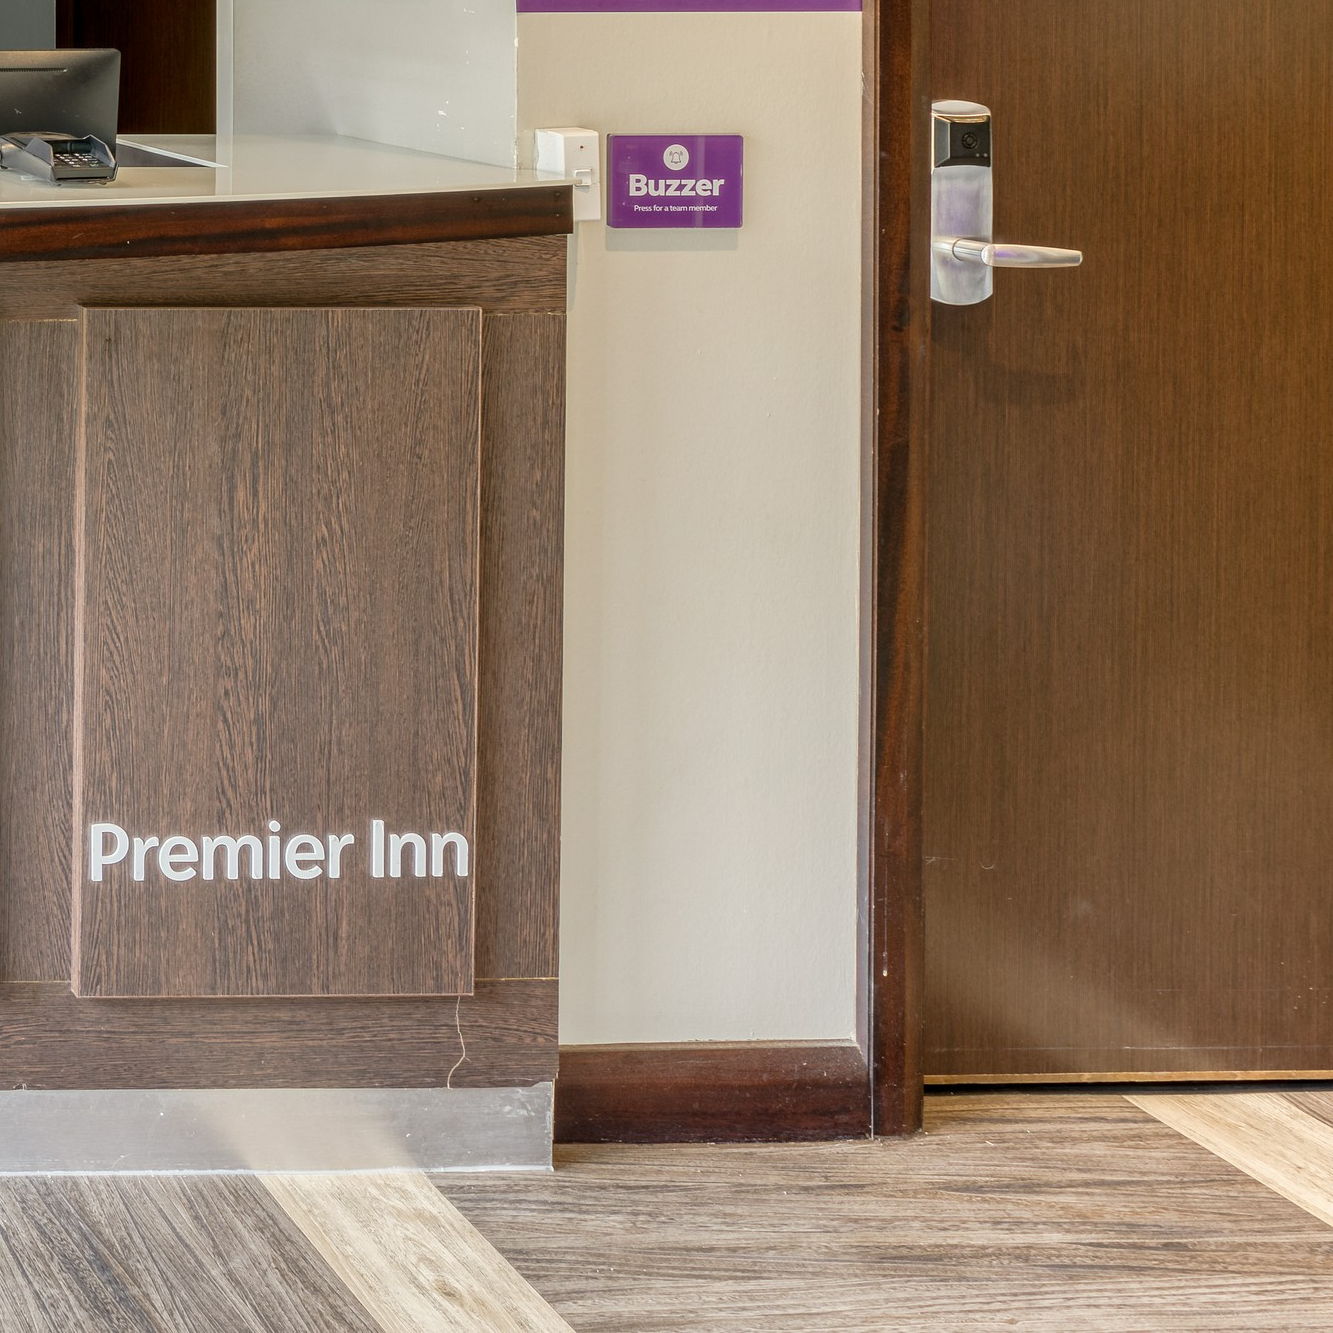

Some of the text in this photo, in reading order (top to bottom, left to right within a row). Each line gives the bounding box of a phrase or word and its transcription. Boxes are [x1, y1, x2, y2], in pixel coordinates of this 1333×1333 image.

[630, 174, 724, 196] Buzzer
[88, 819, 468, 881] Premier Inn
